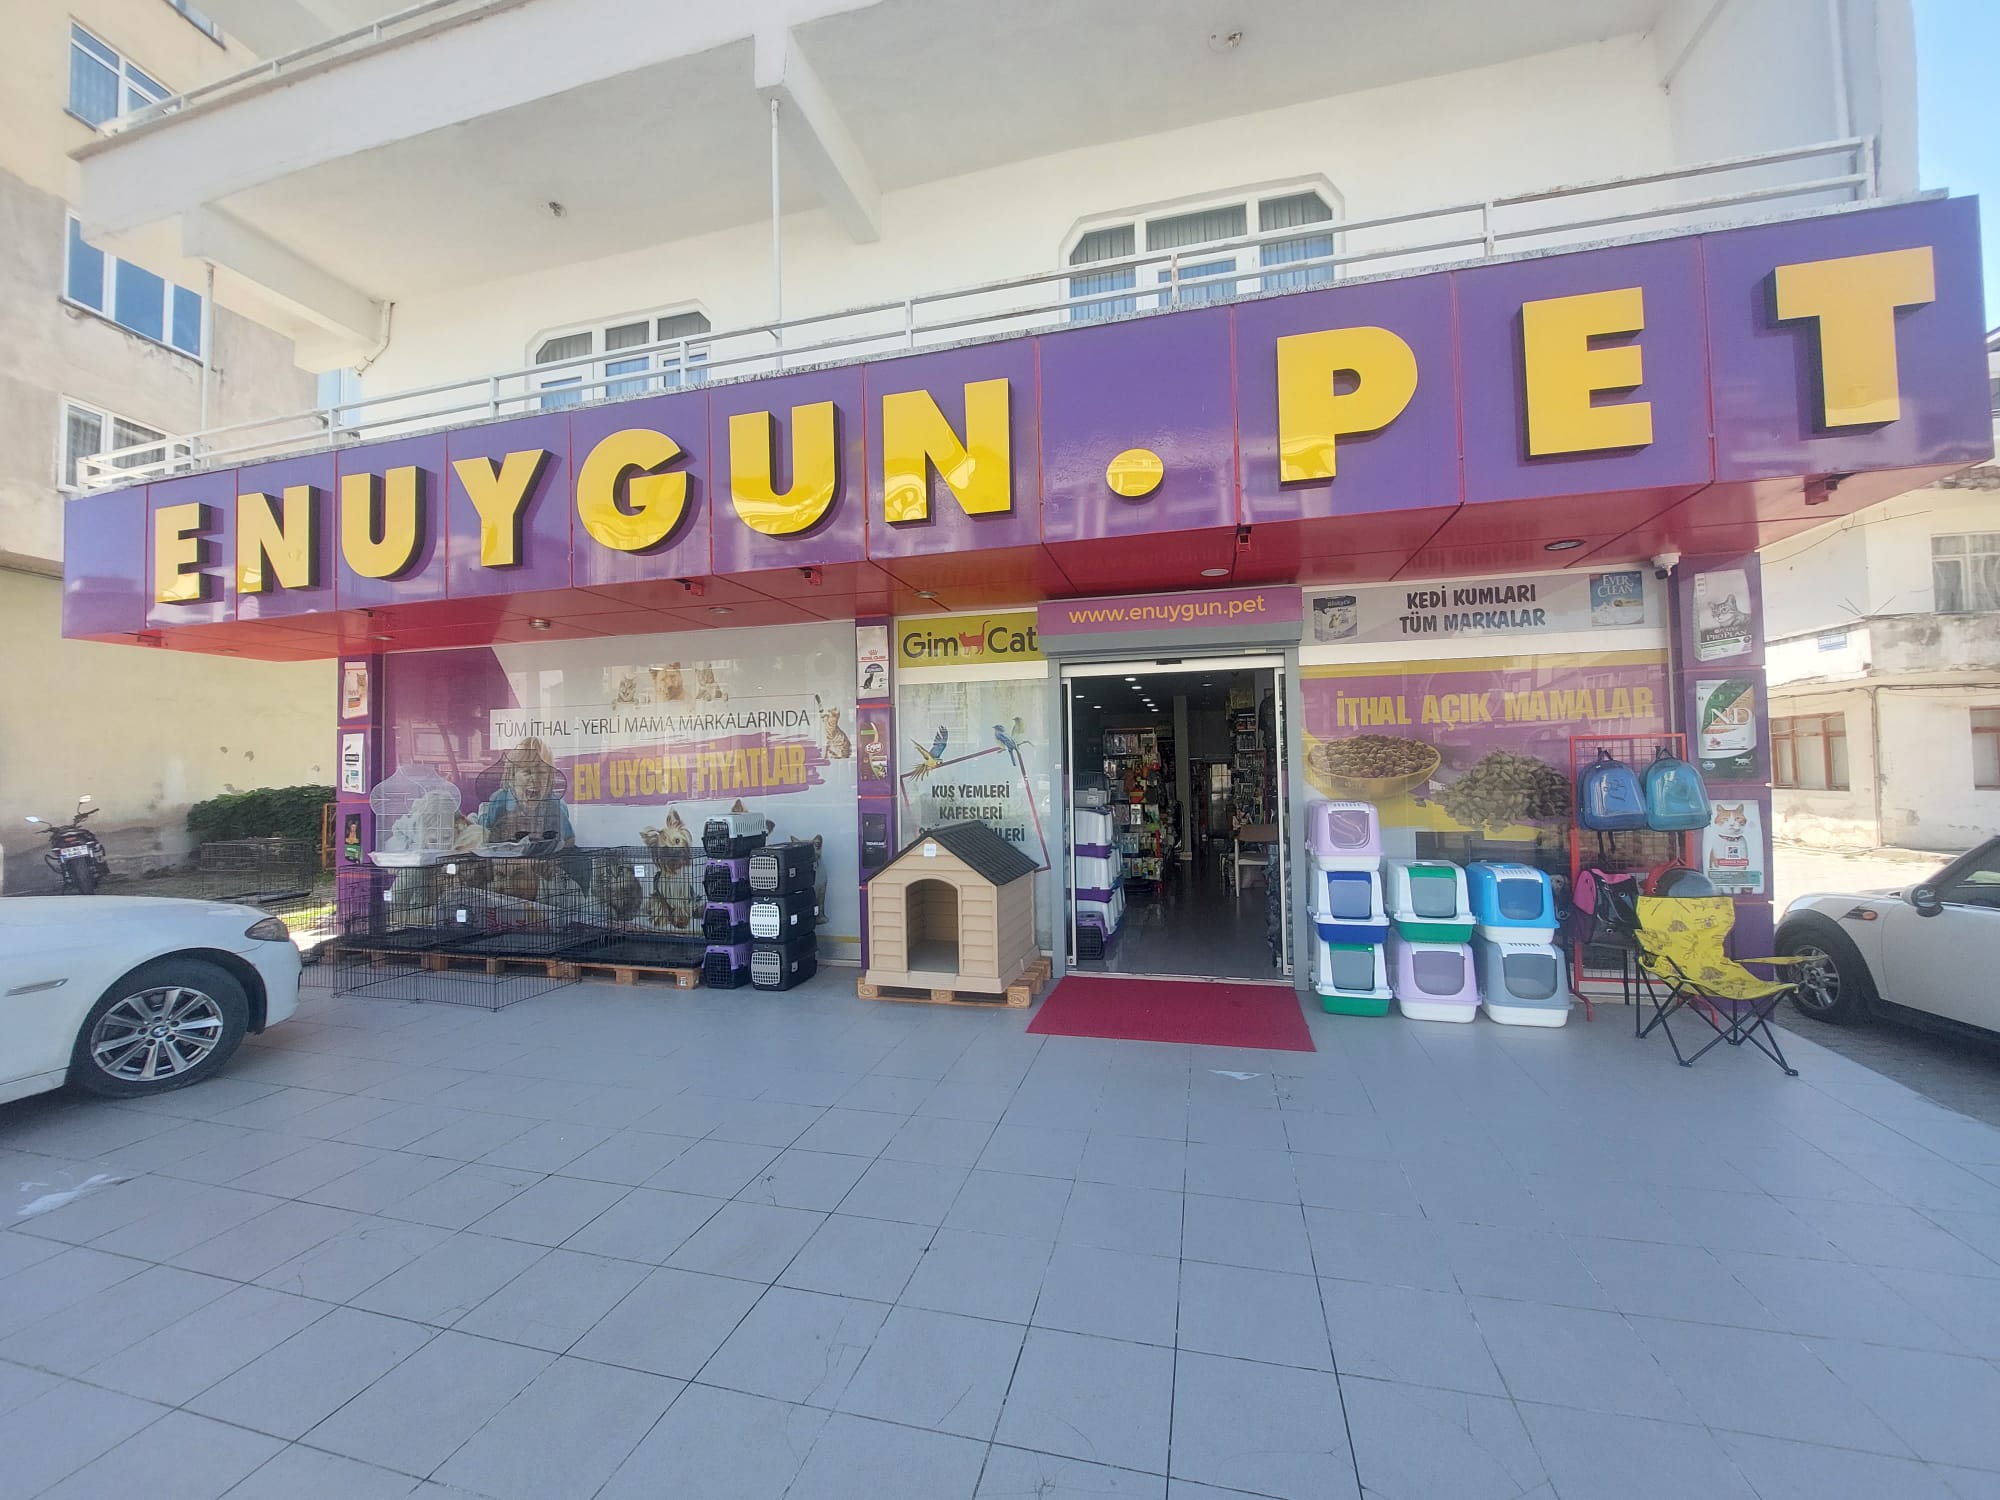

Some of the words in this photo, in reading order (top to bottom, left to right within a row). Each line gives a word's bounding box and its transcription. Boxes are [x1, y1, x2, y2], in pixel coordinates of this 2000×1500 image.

[1597, 584, 1633, 598] CLEAN
[1602, 574, 1634, 587] EVER
[1068, 594, 1266, 624] www.enuygun.pet
[1407, 585, 1448, 610] KEDİ
[1453, 584, 1537, 607] KUMLARI
[1400, 611, 1438, 634] TÜM
[1444, 608, 1546, 632] MARKALAR
[1336, 690, 1412, 727] İTHAL
[1421, 692, 1492, 731] AÇIK
[1503, 687, 1656, 723] MAMALAR
[495, 718, 527, 738] TÜM
[530, 718, 572, 737] İTHAL
[581, 714, 621, 736] YERLİ
[624, 714, 675, 734] MAMA
[678, 709, 810, 732] MARKALARINDA
[573, 762, 601, 801] EN
[609, 754, 688, 799] UYGUN
[696, 741, 807, 792] FİYATLAR
[931, 784, 955, 802] KUŞ
[958, 781, 1010, 799] YEMLERİ
[939, 802, 1003, 820] KAFESLERİ
